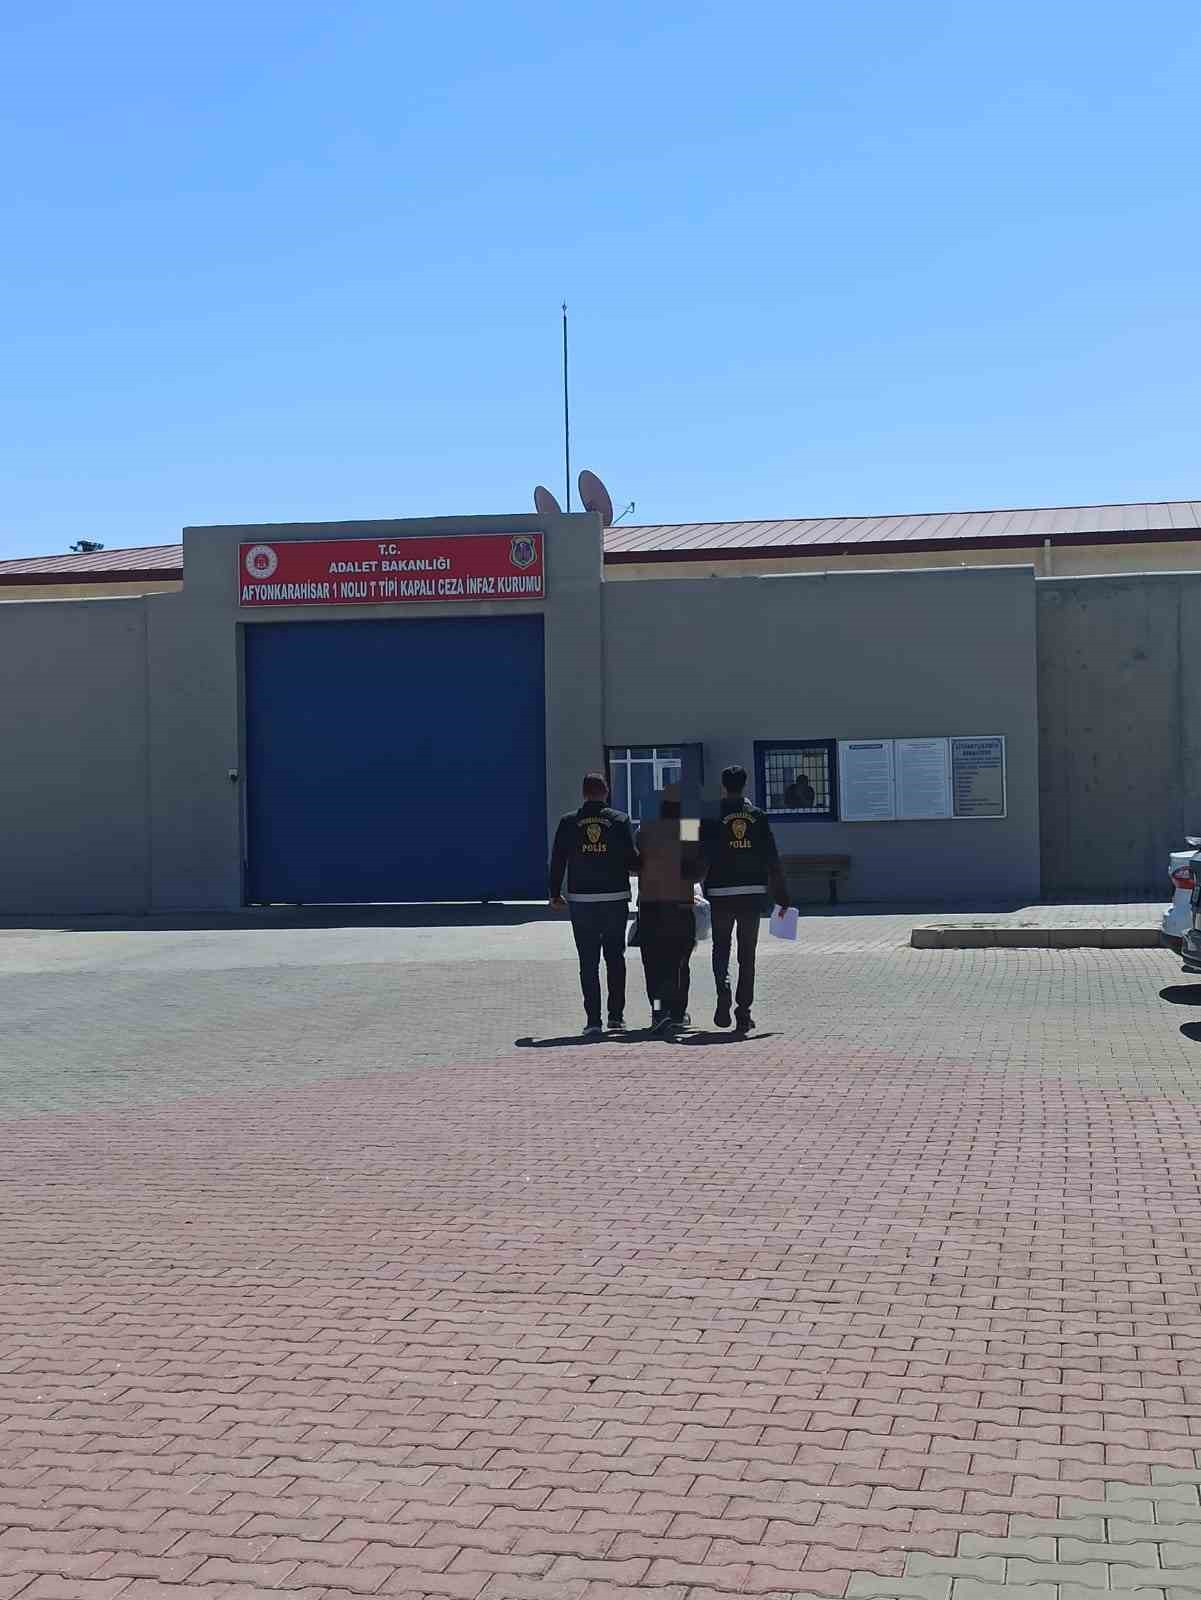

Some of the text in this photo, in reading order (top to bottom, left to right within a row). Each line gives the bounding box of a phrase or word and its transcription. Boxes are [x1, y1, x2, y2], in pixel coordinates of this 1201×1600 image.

[378, 544, 401, 555] T.C.
[329, 557, 451, 573] ADALET BAKANLIĞI
[242, 574, 541, 601] AFYONKARAHİSAR 1 NOLU T TİPİ KAPALI CEZA İNFAZ KURUMU
